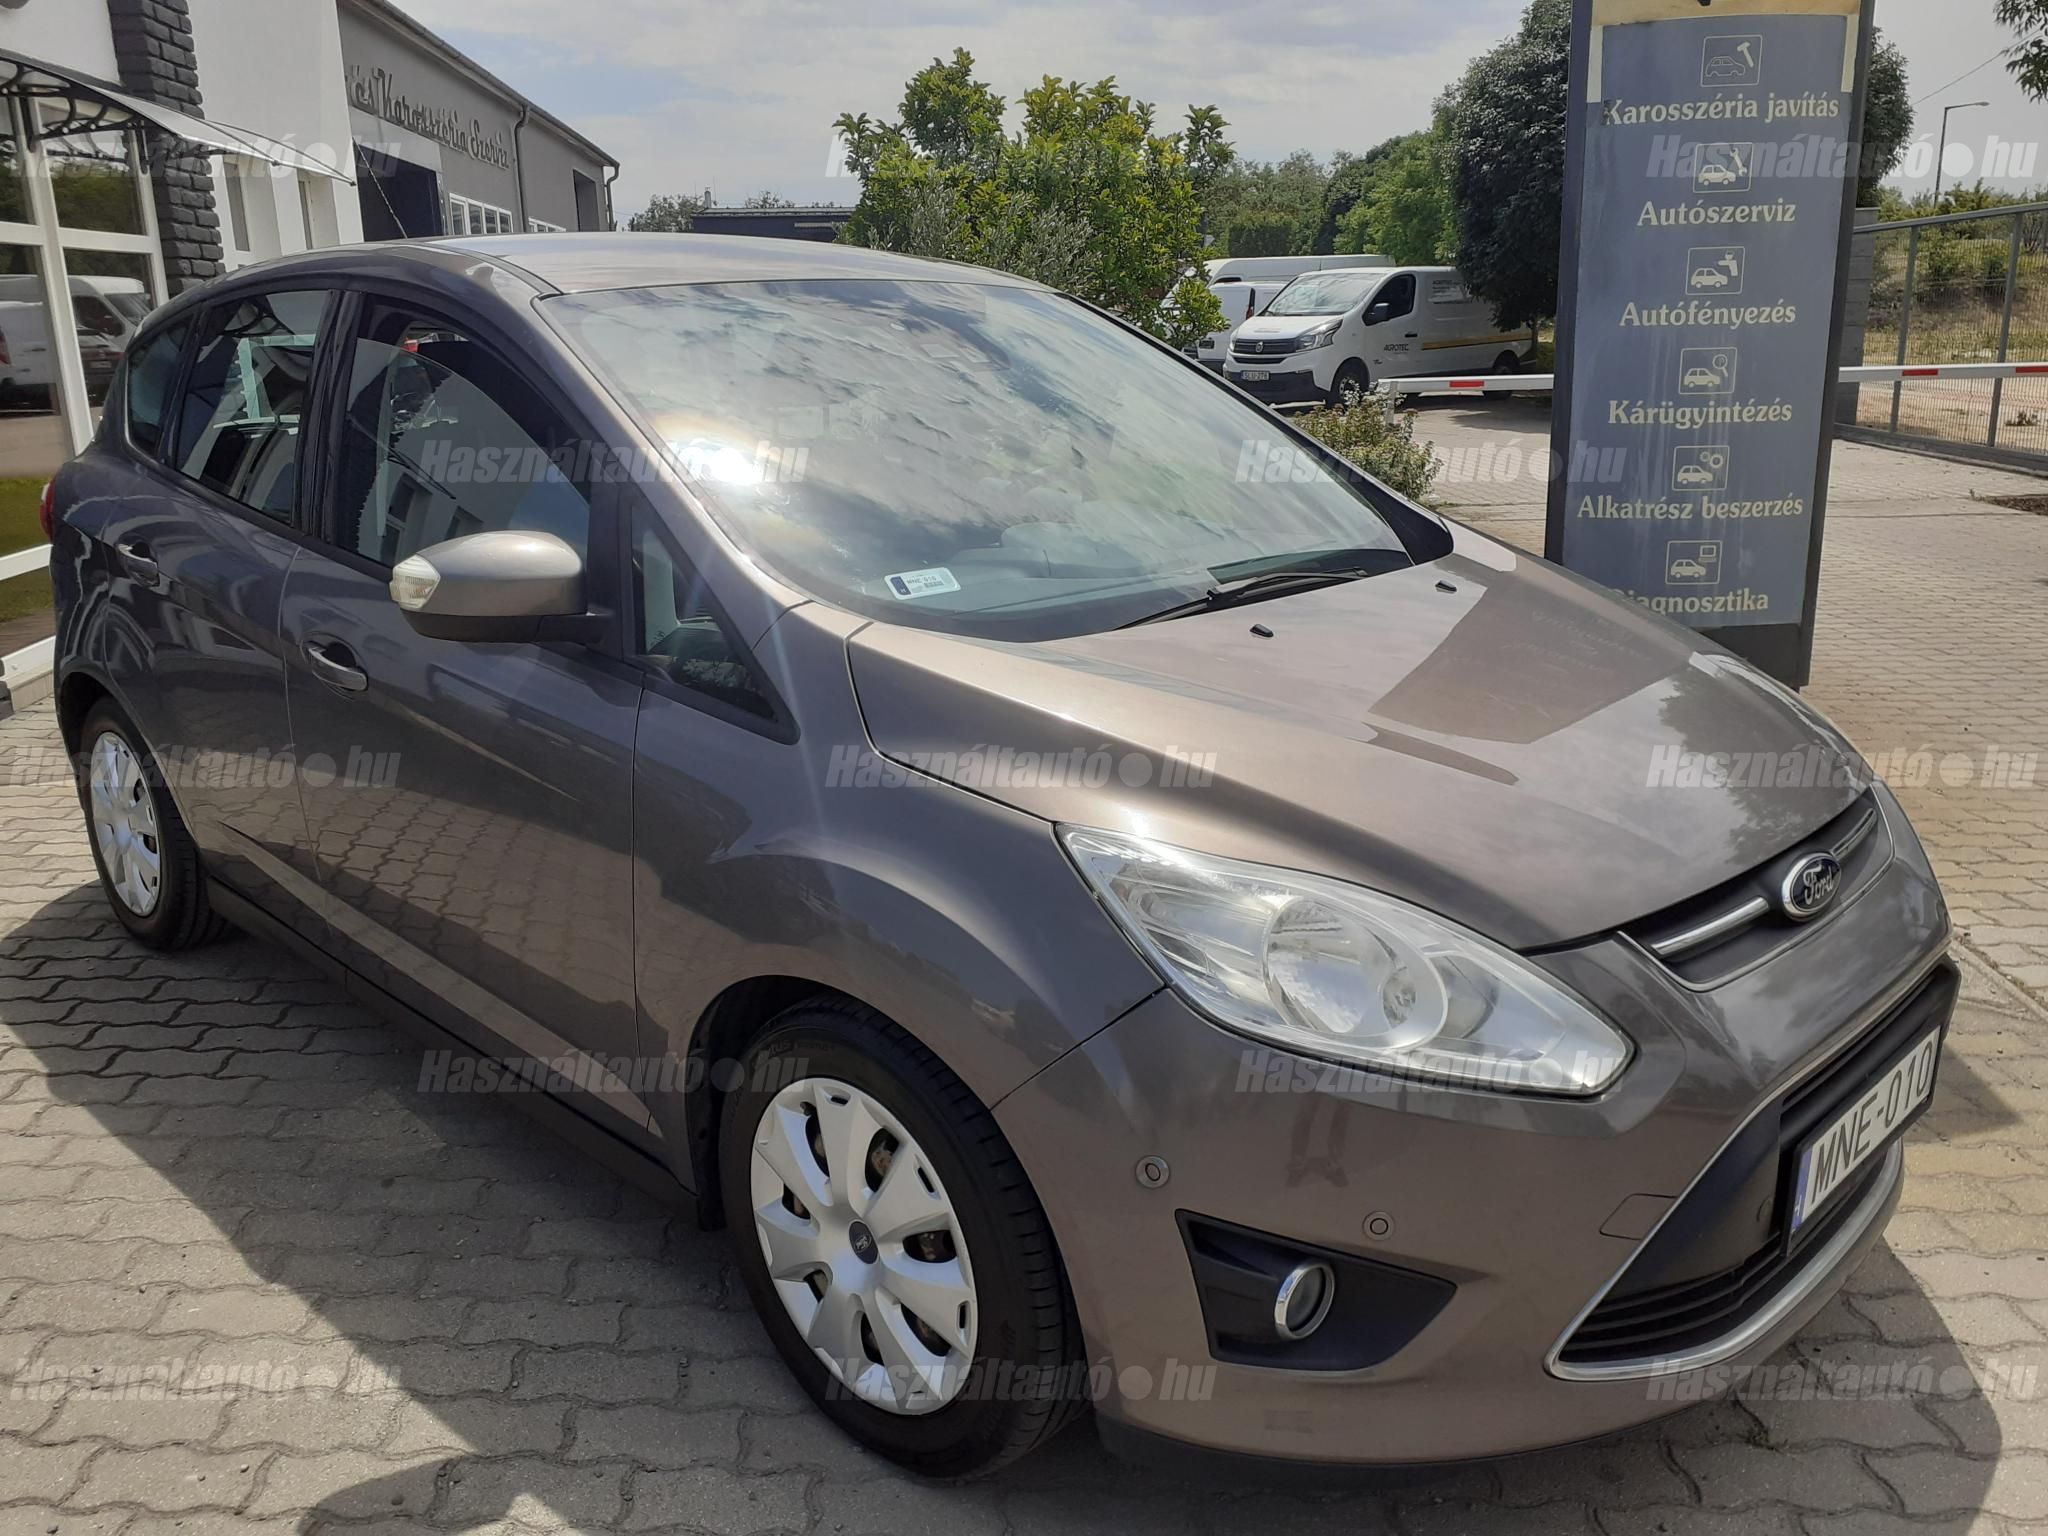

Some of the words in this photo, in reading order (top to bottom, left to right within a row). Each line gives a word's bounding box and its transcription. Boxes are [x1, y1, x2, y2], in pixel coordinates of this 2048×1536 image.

[1605, 92, 1759, 126] Karosszéria
[1764, 91, 1840, 124] javítás
[1636, 197, 1797, 227] Autószerviz
[1618, 298, 1797, 330] Autófényezés
[1607, 397, 1793, 430] Kárügyintézés
[1577, 494, 1694, 520] Alkatrész
[1702, 493, 1804, 519] beszerzés
[1611, 587, 1769, 617] agnosztika
[1804, 864, 1834, 905] Ford
[1810, 1040, 1934, 1203] MNE-010
